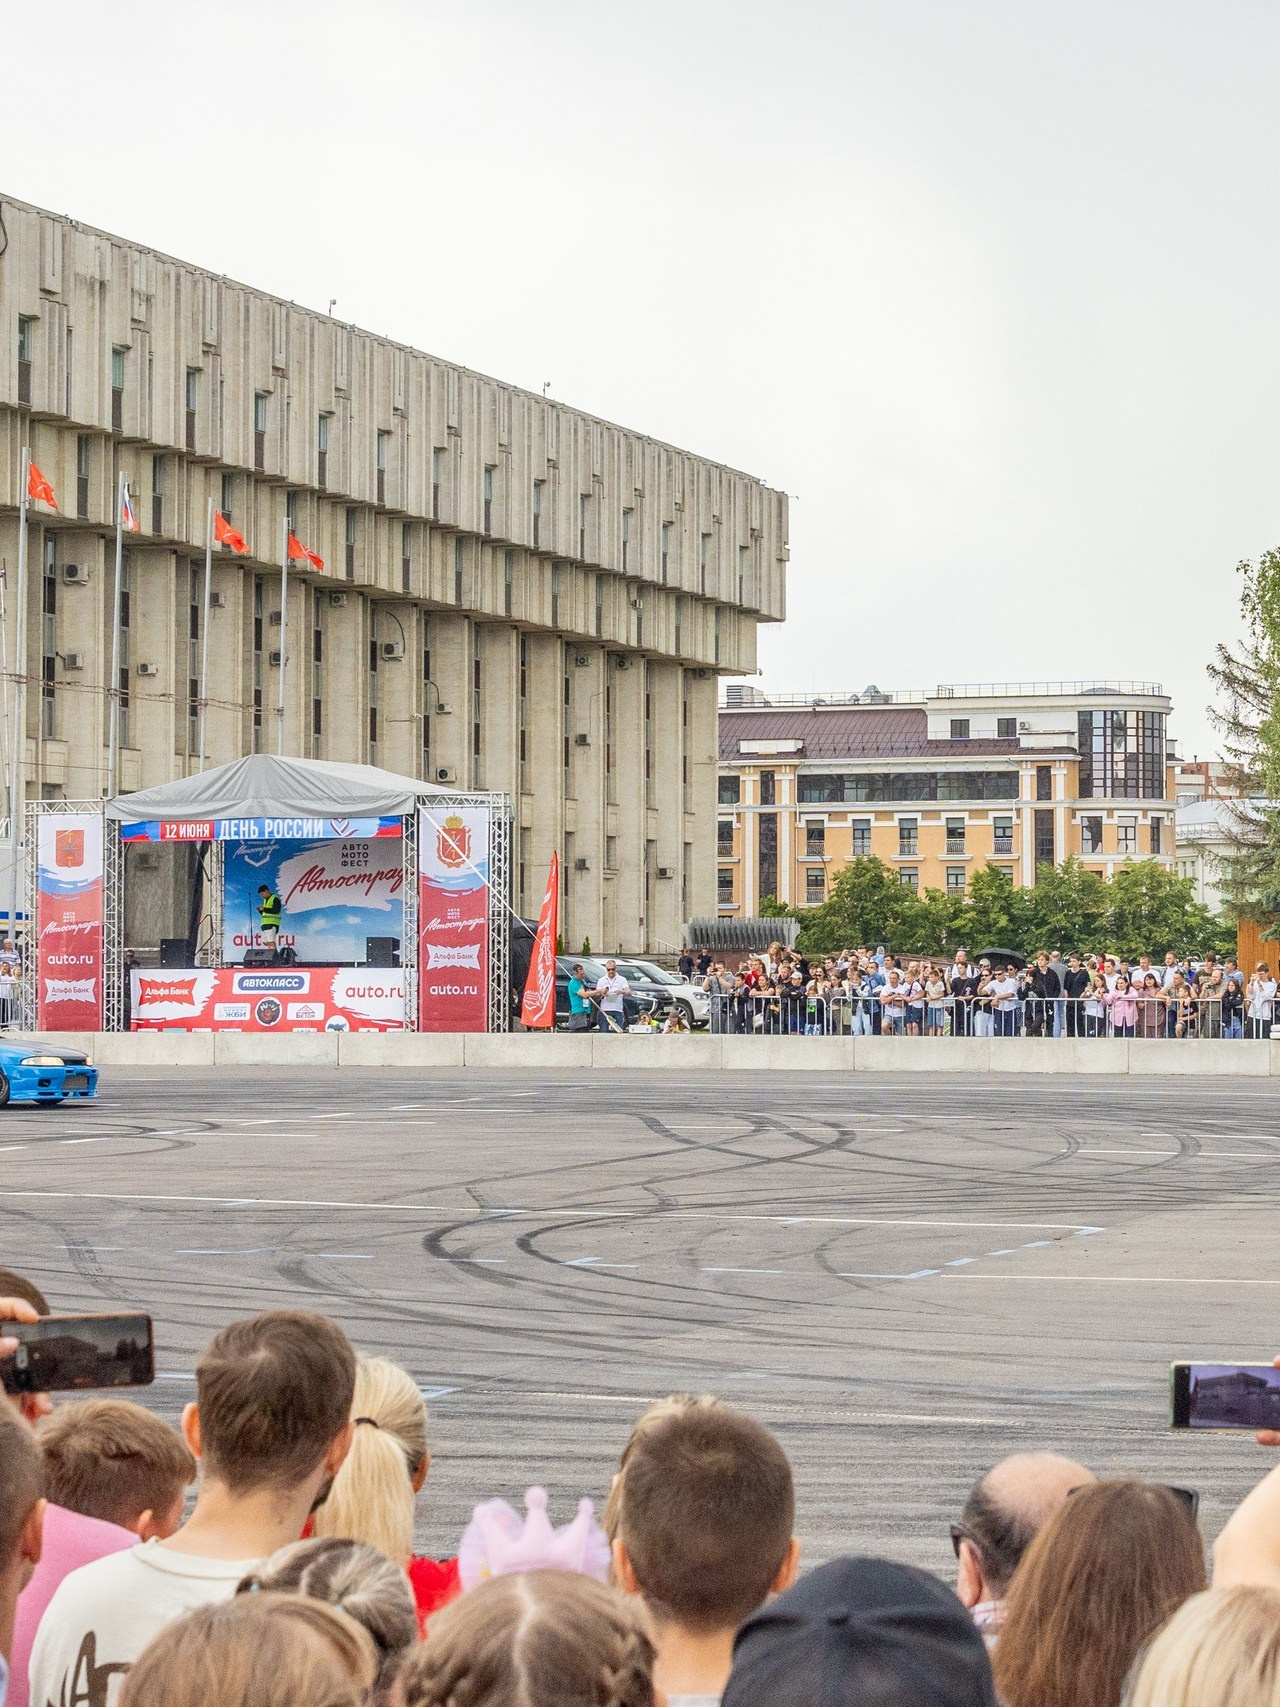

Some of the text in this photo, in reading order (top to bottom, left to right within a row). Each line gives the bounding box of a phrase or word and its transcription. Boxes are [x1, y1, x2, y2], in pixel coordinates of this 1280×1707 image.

[165, 818, 324, 840] 12 ИЮНЯ ДЕНЬ РОССИИ
[341, 843, 369, 851] АВТО
[341, 851, 369, 859] МОТО
[233, 933, 295, 947] autru
[47, 953, 93, 965] auto.ru
[433, 952, 474, 961] Альфа Банк
[242, 978, 300, 988] АВТОКЛАСС
[51, 986, 72, 995] Альфа
[145, 987, 190, 997] Альфа Банк
[429, 984, 478, 995] auto.ru
